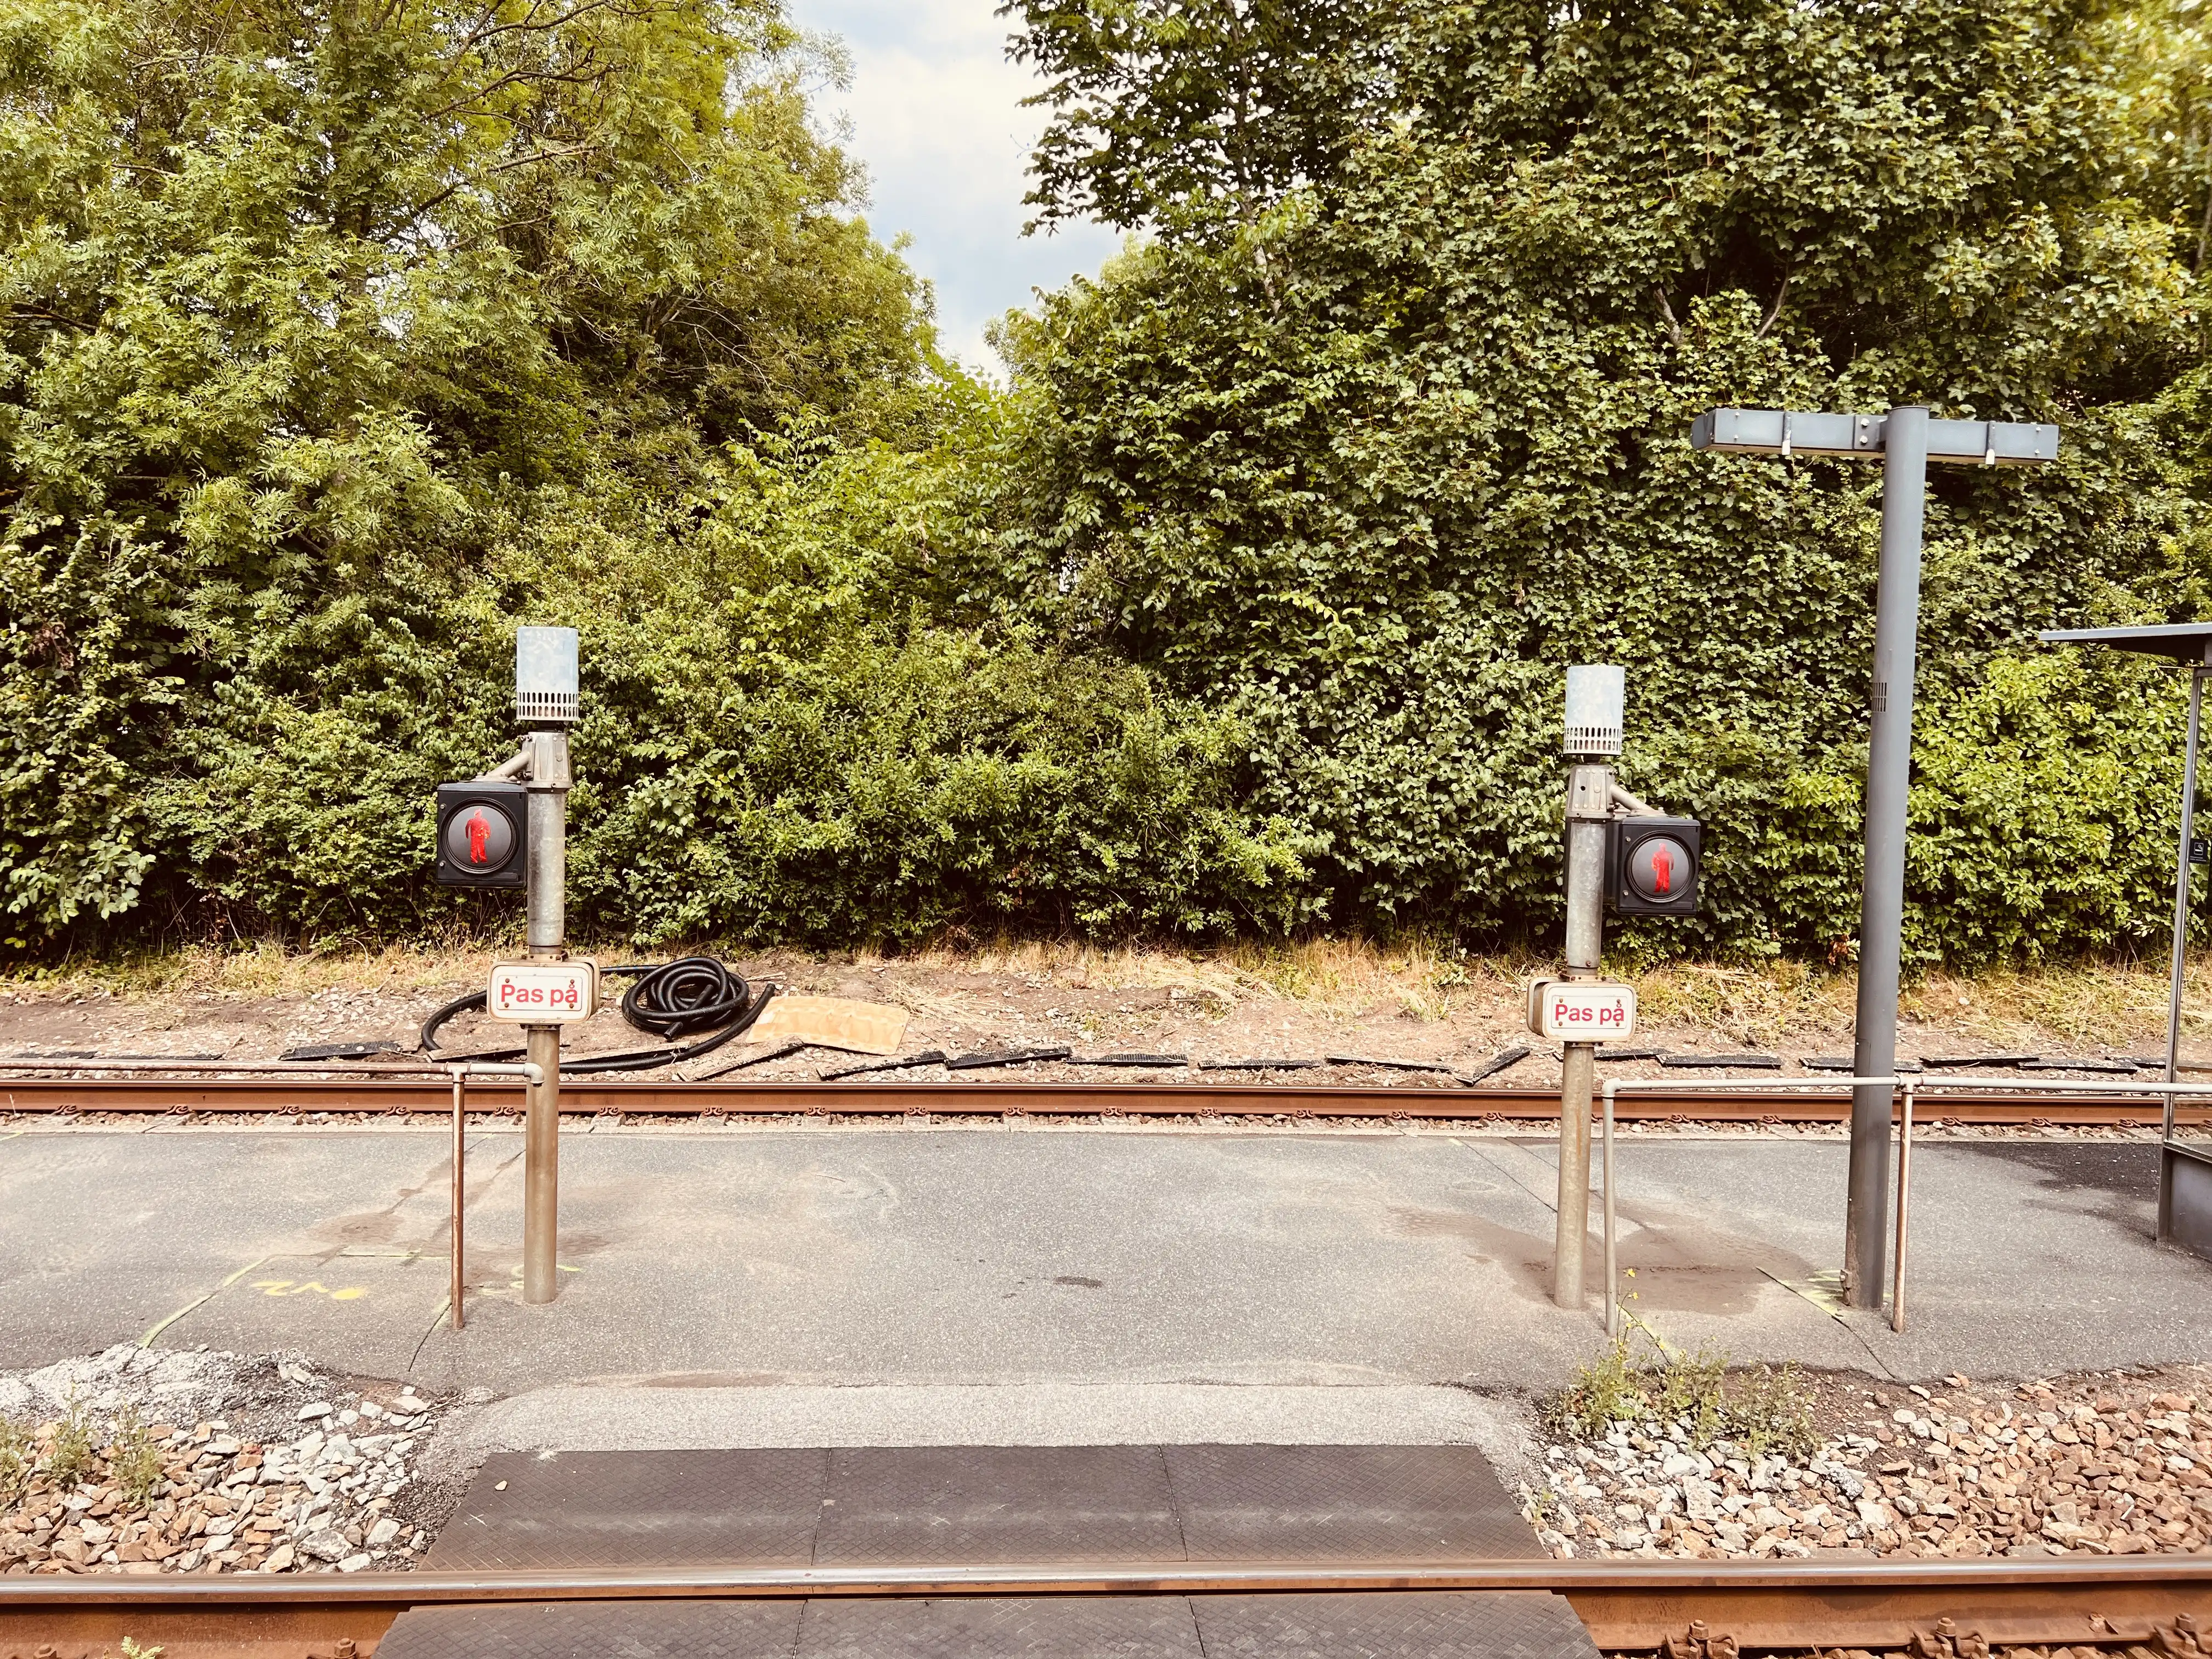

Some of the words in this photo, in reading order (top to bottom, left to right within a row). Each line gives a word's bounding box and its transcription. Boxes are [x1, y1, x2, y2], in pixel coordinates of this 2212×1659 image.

[501, 984, 543, 1003] Pas
[550, 984, 578, 1007] på
[1555, 1004, 1593, 1022] Pas
[1600, 1003, 1624, 1025] på
